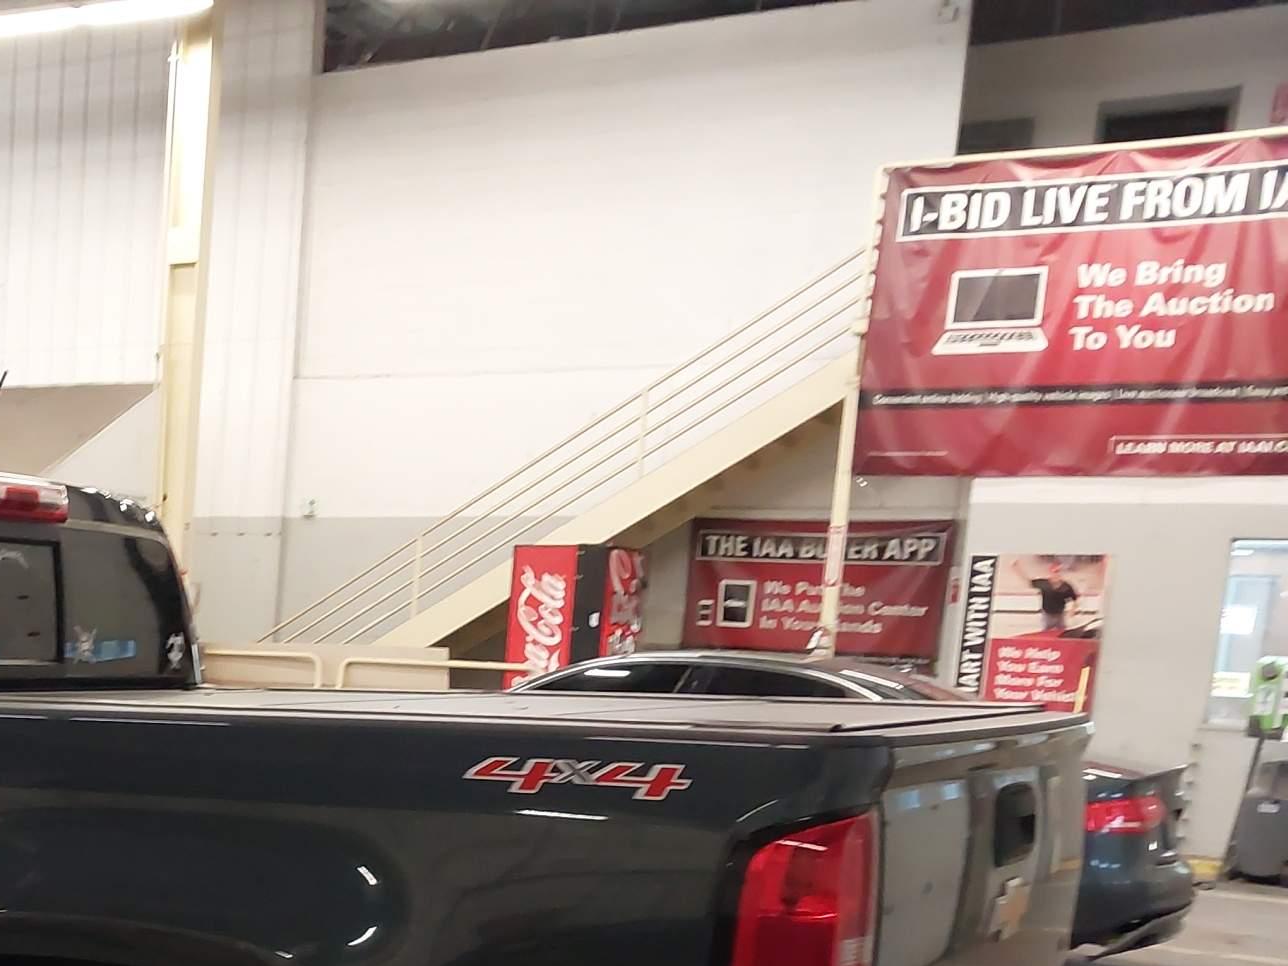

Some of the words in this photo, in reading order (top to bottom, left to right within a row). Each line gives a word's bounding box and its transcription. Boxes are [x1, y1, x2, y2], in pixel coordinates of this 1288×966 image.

[910, 191, 1011, 233] I-BID
[1021, 183, 1118, 227] LIVE
[1119, 172, 1251, 221] FROM
[1077, 262, 1127, 288] We
[1134, 259, 1228, 288] Bring
[1073, 294, 1135, 320] The
[1139, 288, 1276, 318] Auction
[1068, 326, 1108, 351] To
[1115, 324, 1177, 350] You
[706, 534, 750, 558] THE
[751, 536, 795, 559] IAA
[798, 539, 879, 560] BUER
[883, 536, 937, 561] APP
[971, 558, 997, 592] IAA
